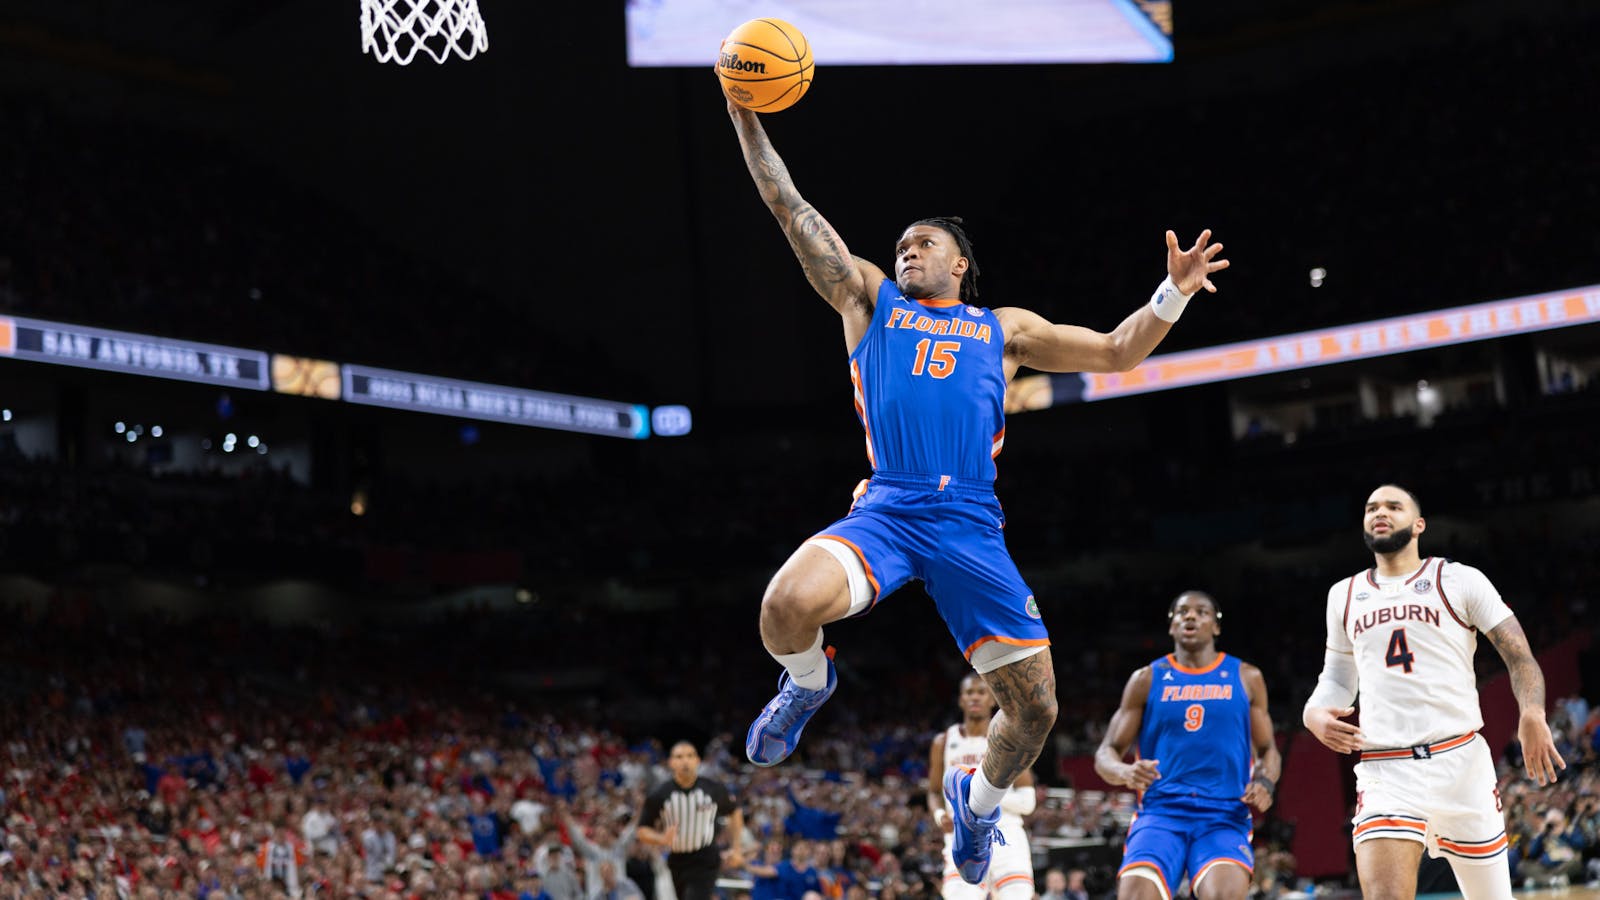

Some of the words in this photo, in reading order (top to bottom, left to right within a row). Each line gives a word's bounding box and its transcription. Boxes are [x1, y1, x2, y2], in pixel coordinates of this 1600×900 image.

[43, 329, 91, 358] SAN
[885, 307, 991, 344] FLORIDA
[1253, 340, 1321, 368] AND
[1335, 322, 1428, 355] THEN
[1445, 299, 1566, 338] THERE
[912, 338, 961, 379] 15
[937, 475, 951, 491] F
[1353, 604, 1440, 640] AUBURN
[1385, 627, 1415, 674] 4
[1161, 684, 1233, 702] FLORIDA
[1184, 704, 1205, 731] 9
